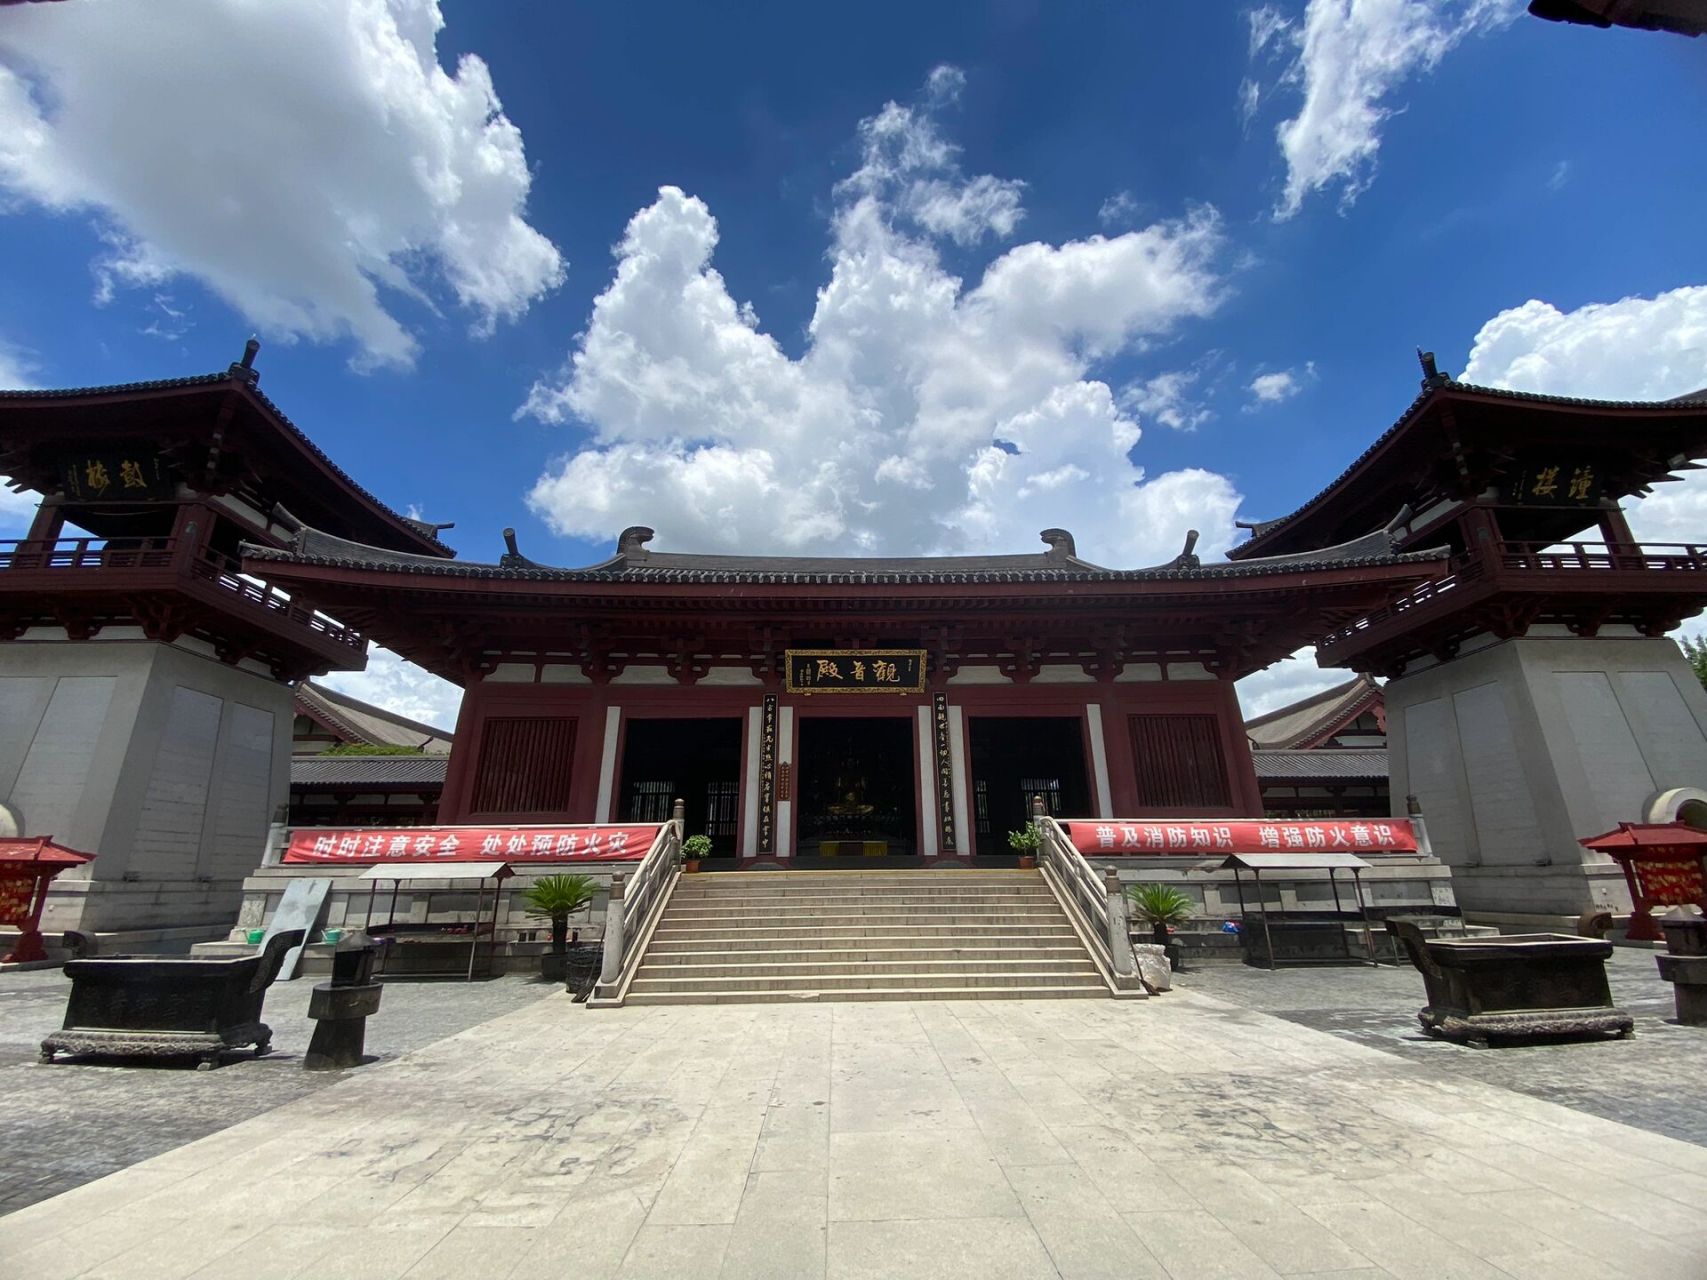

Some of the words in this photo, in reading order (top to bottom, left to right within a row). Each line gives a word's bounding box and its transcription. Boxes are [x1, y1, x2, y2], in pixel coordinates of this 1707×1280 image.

[816, 659, 901, 683] 觀音殿
[312, 834, 461, 858] 时时注意安全
[480, 832, 629, 857] 处处预防火灾
[1095, 826, 1234, 849] 普及消防知识
[1259, 825, 1397, 848] 增强防火意识
